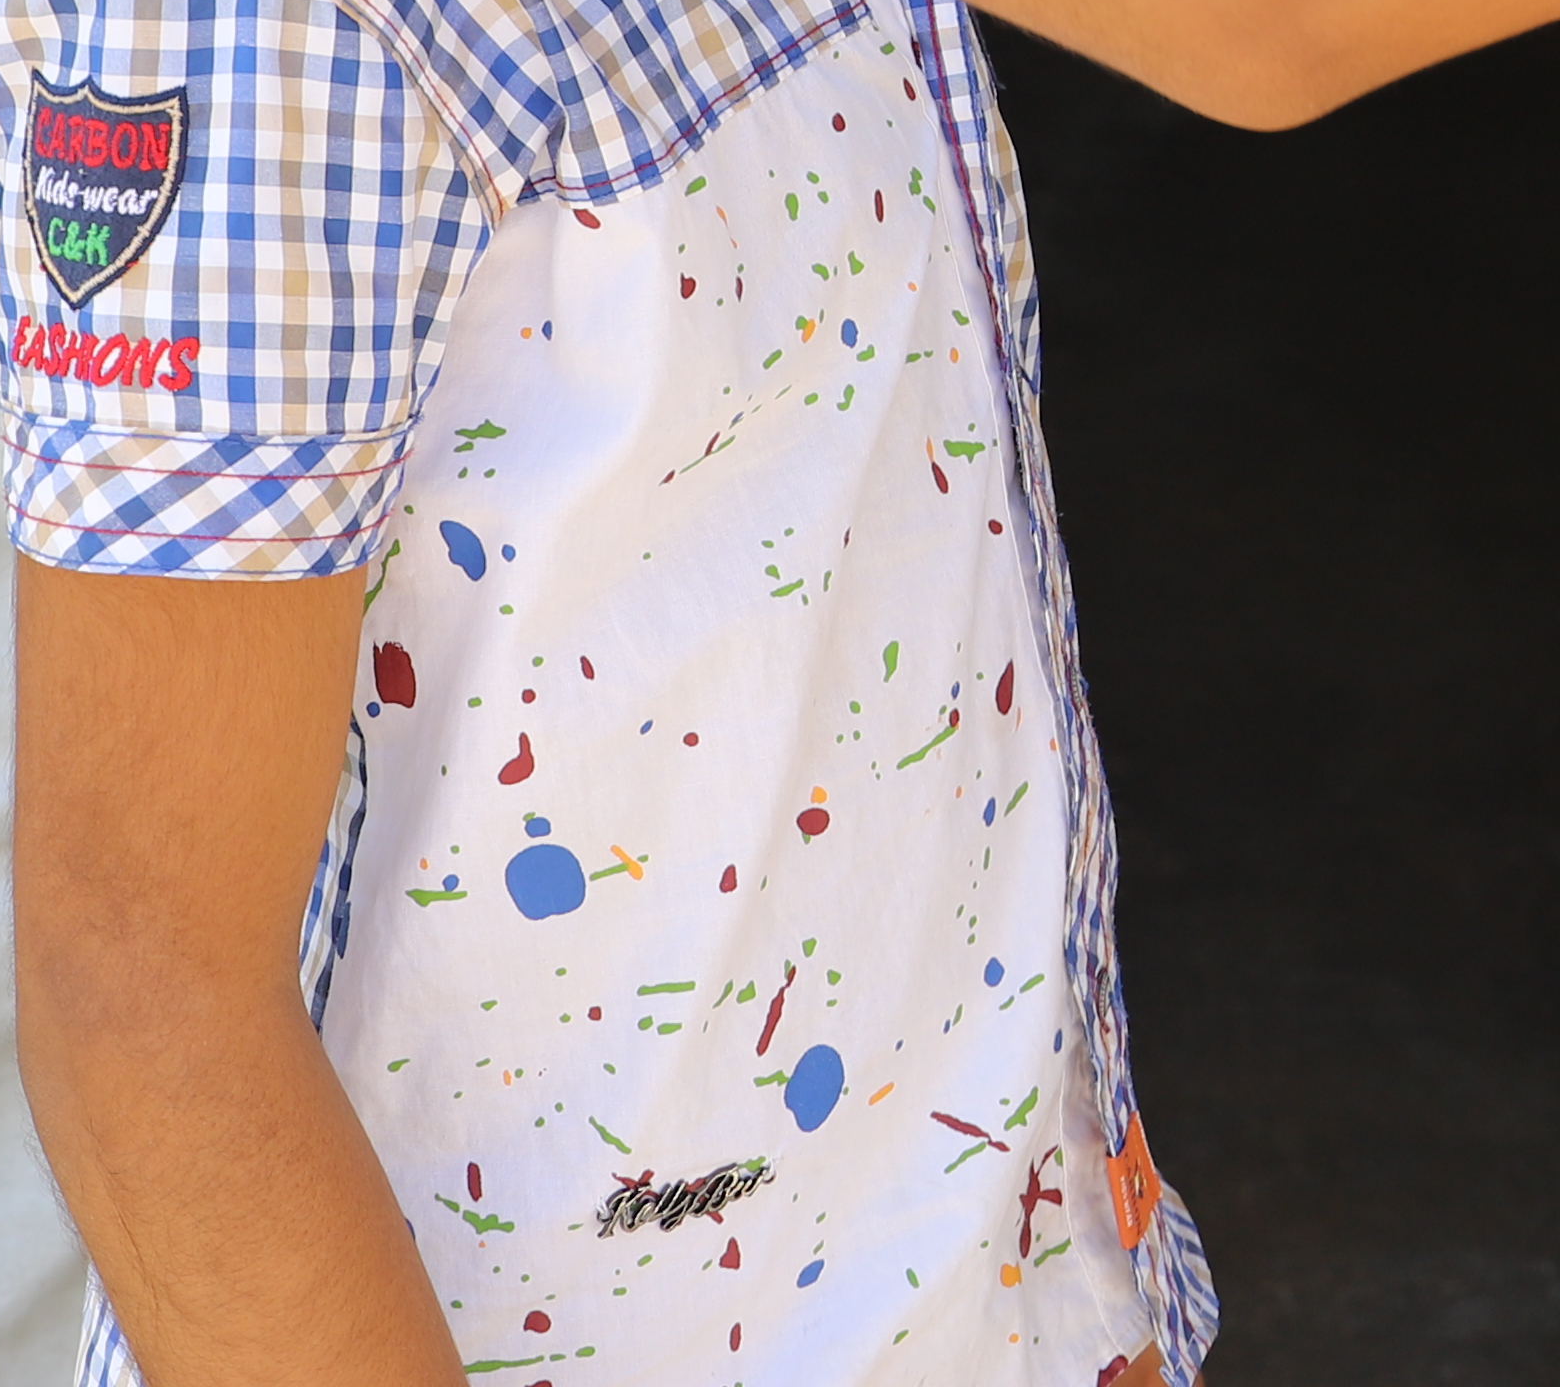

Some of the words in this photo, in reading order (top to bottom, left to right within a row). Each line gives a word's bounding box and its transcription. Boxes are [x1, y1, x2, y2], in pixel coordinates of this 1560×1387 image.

[35, 106, 170, 170] CARBON
[35, 165, 159, 216] Kids-wear
[12, 314, 201, 392] FASHIONS
